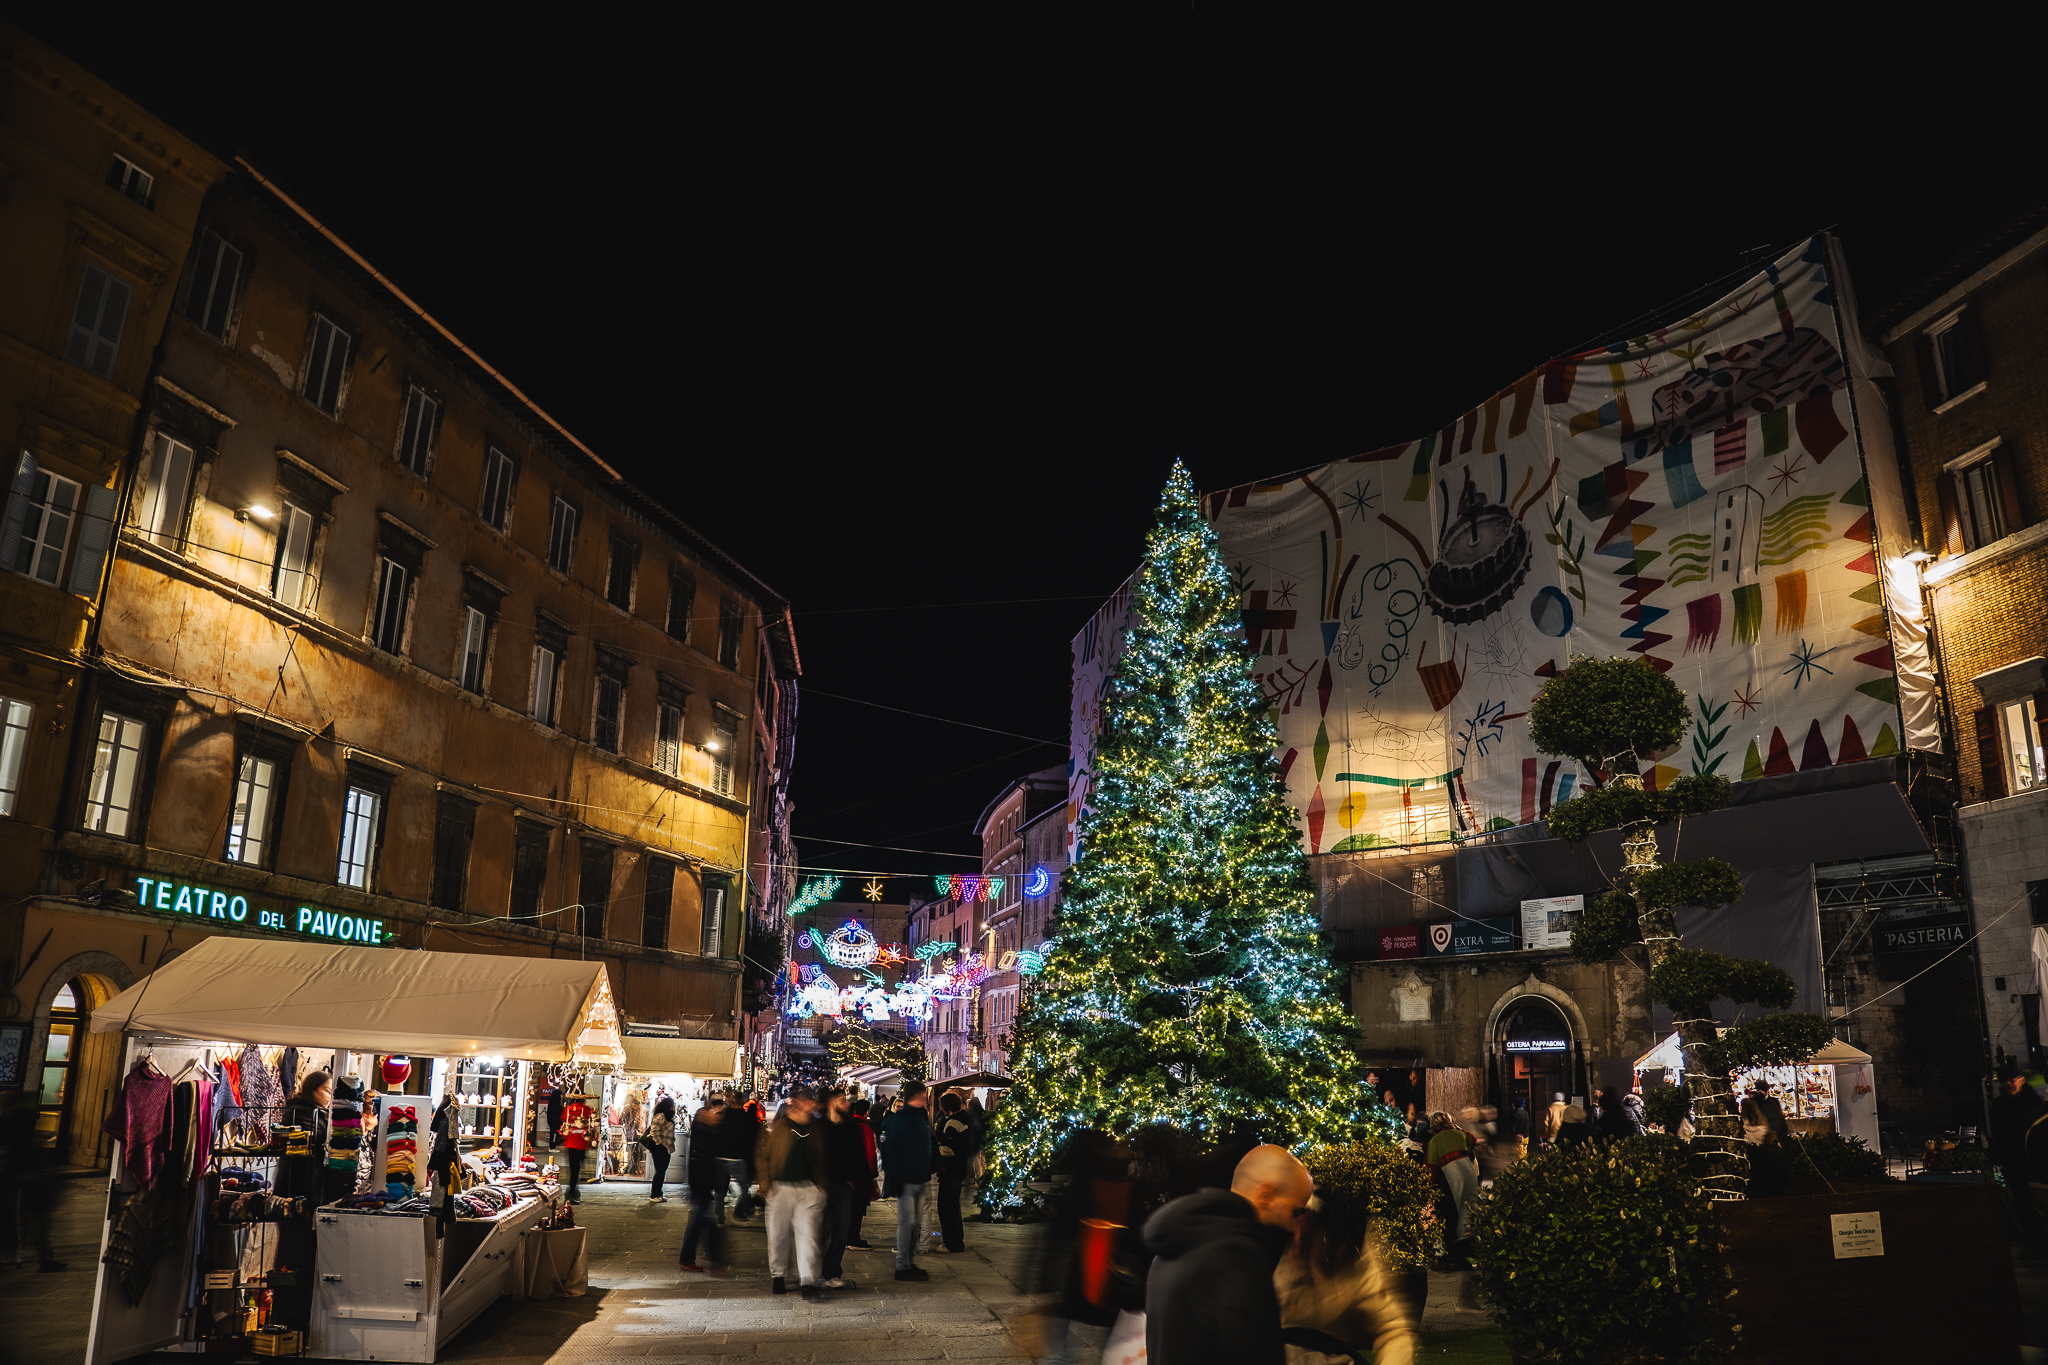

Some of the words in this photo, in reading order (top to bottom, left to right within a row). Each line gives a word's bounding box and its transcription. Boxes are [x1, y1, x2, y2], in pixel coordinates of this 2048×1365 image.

[137, 877, 248, 922] TEATRO
[259, 910, 286, 929] DEL
[297, 907, 383, 944] PAVONE
[1454, 936, 1484, 947] EXTRA
[1884, 927, 1963, 946] PASTERIA
[1394, 941, 1417, 949] PERUGIA
